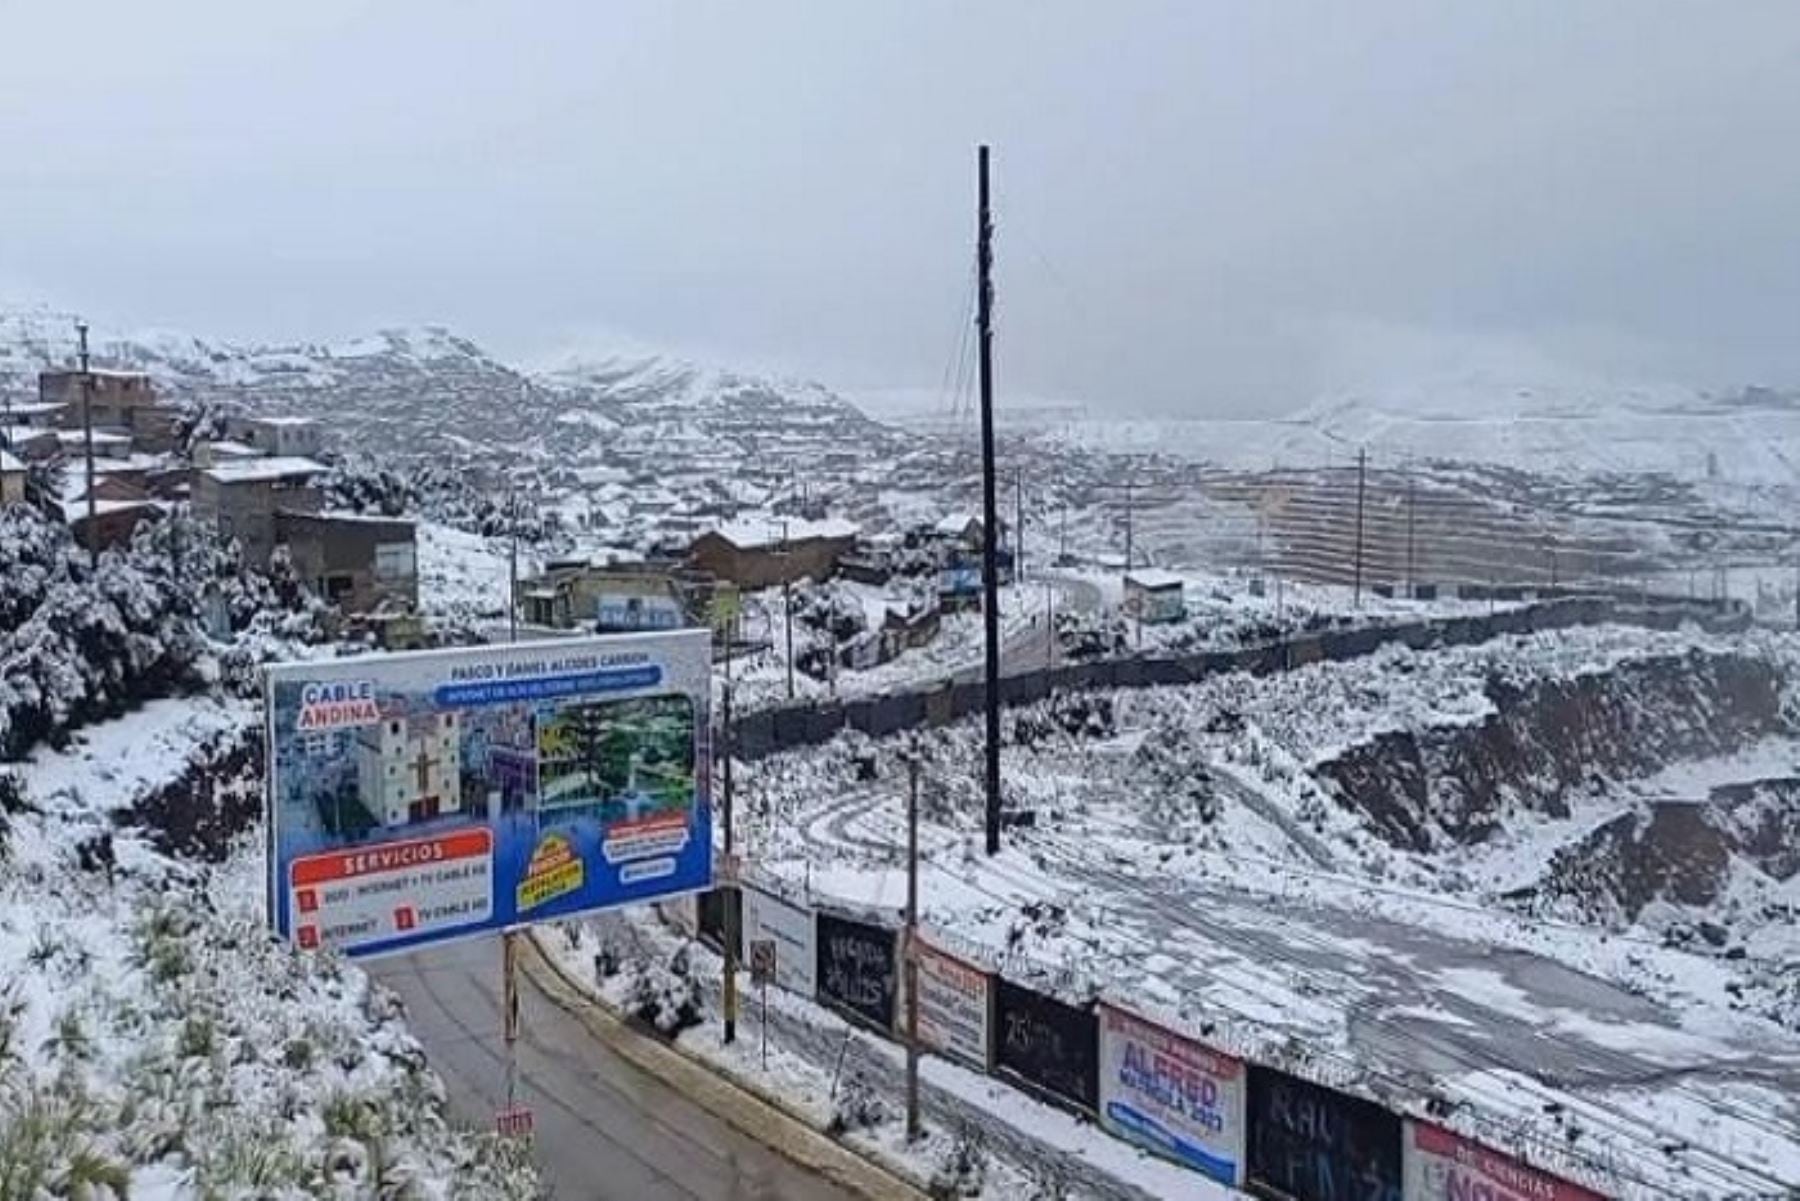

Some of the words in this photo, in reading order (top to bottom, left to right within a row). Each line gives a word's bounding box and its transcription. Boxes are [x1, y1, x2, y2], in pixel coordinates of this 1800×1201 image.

[304, 681, 371, 706] CABLE
[300, 702, 376, 728] ANDINA
[344, 841, 444, 875] SERVICIOS
[1122, 1041, 1217, 1108] ALFRED
